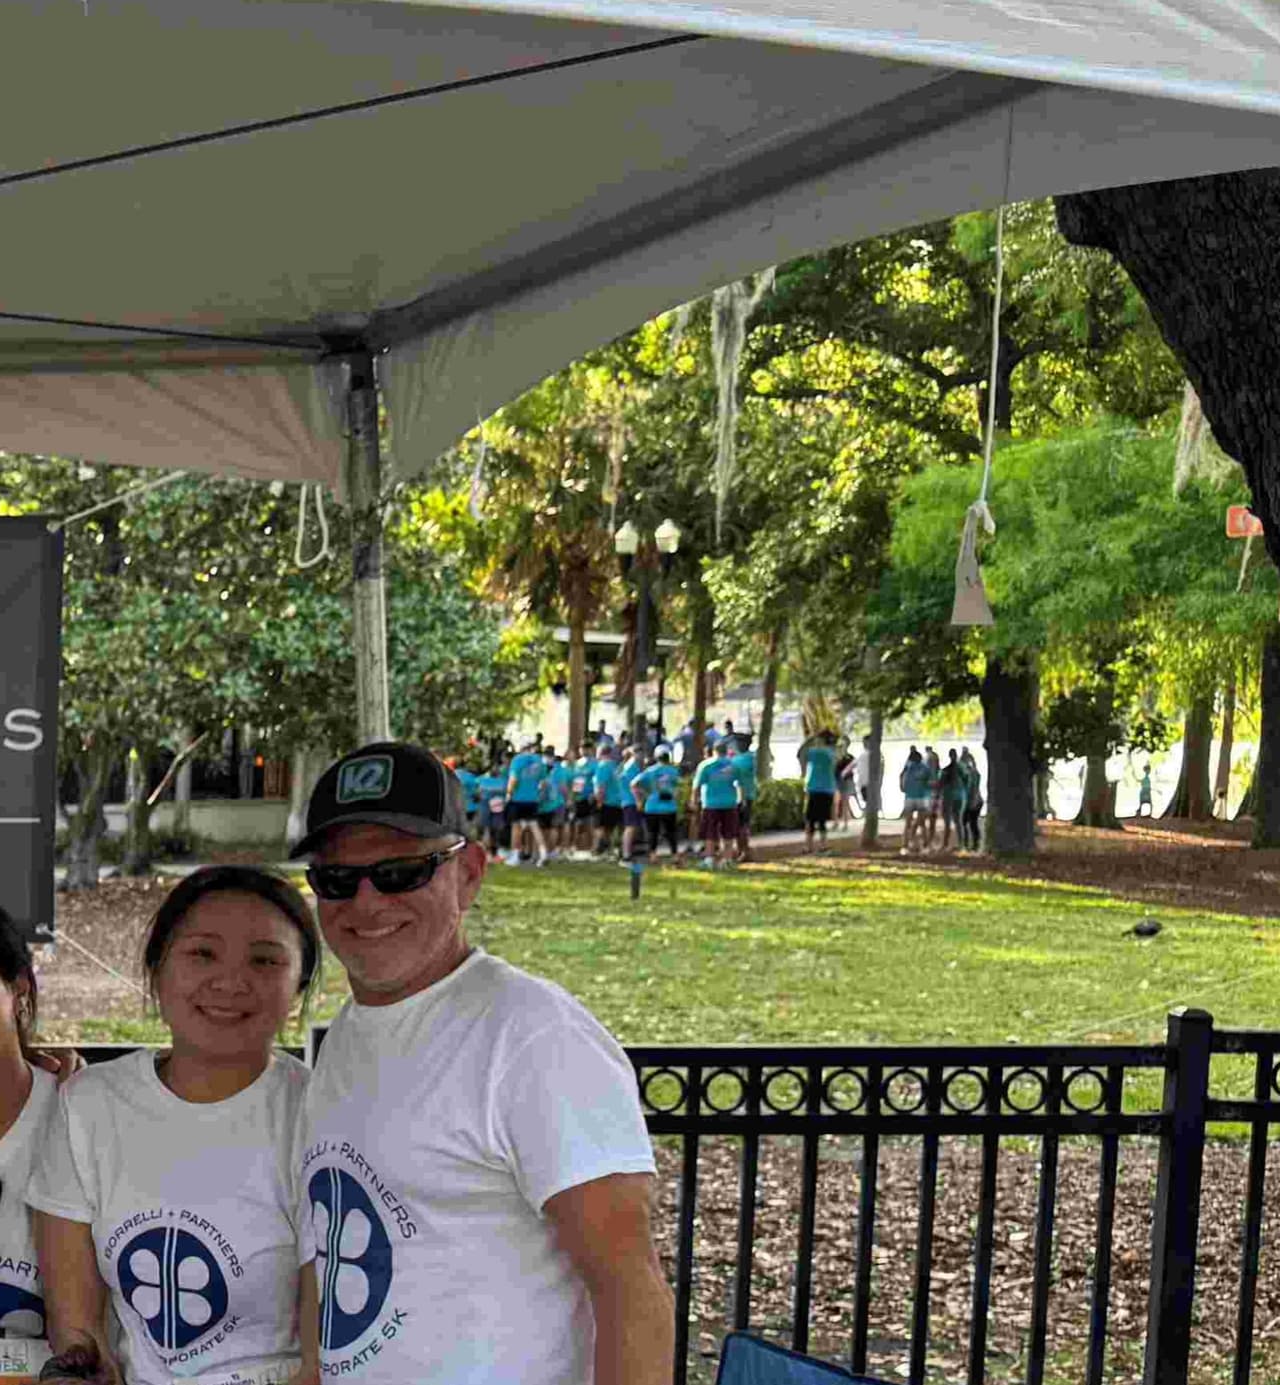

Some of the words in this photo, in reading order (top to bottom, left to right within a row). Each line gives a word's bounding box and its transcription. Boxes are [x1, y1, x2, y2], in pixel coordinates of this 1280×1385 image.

[340, 1141, 417, 1240] PARTNERS
[104, 1207, 163, 1261] BORRELLI
[180, 1208, 245, 1279] PARTNERS
[321, 1339, 384, 1378] PORATE
[381, 1307, 409, 1341] 5K
